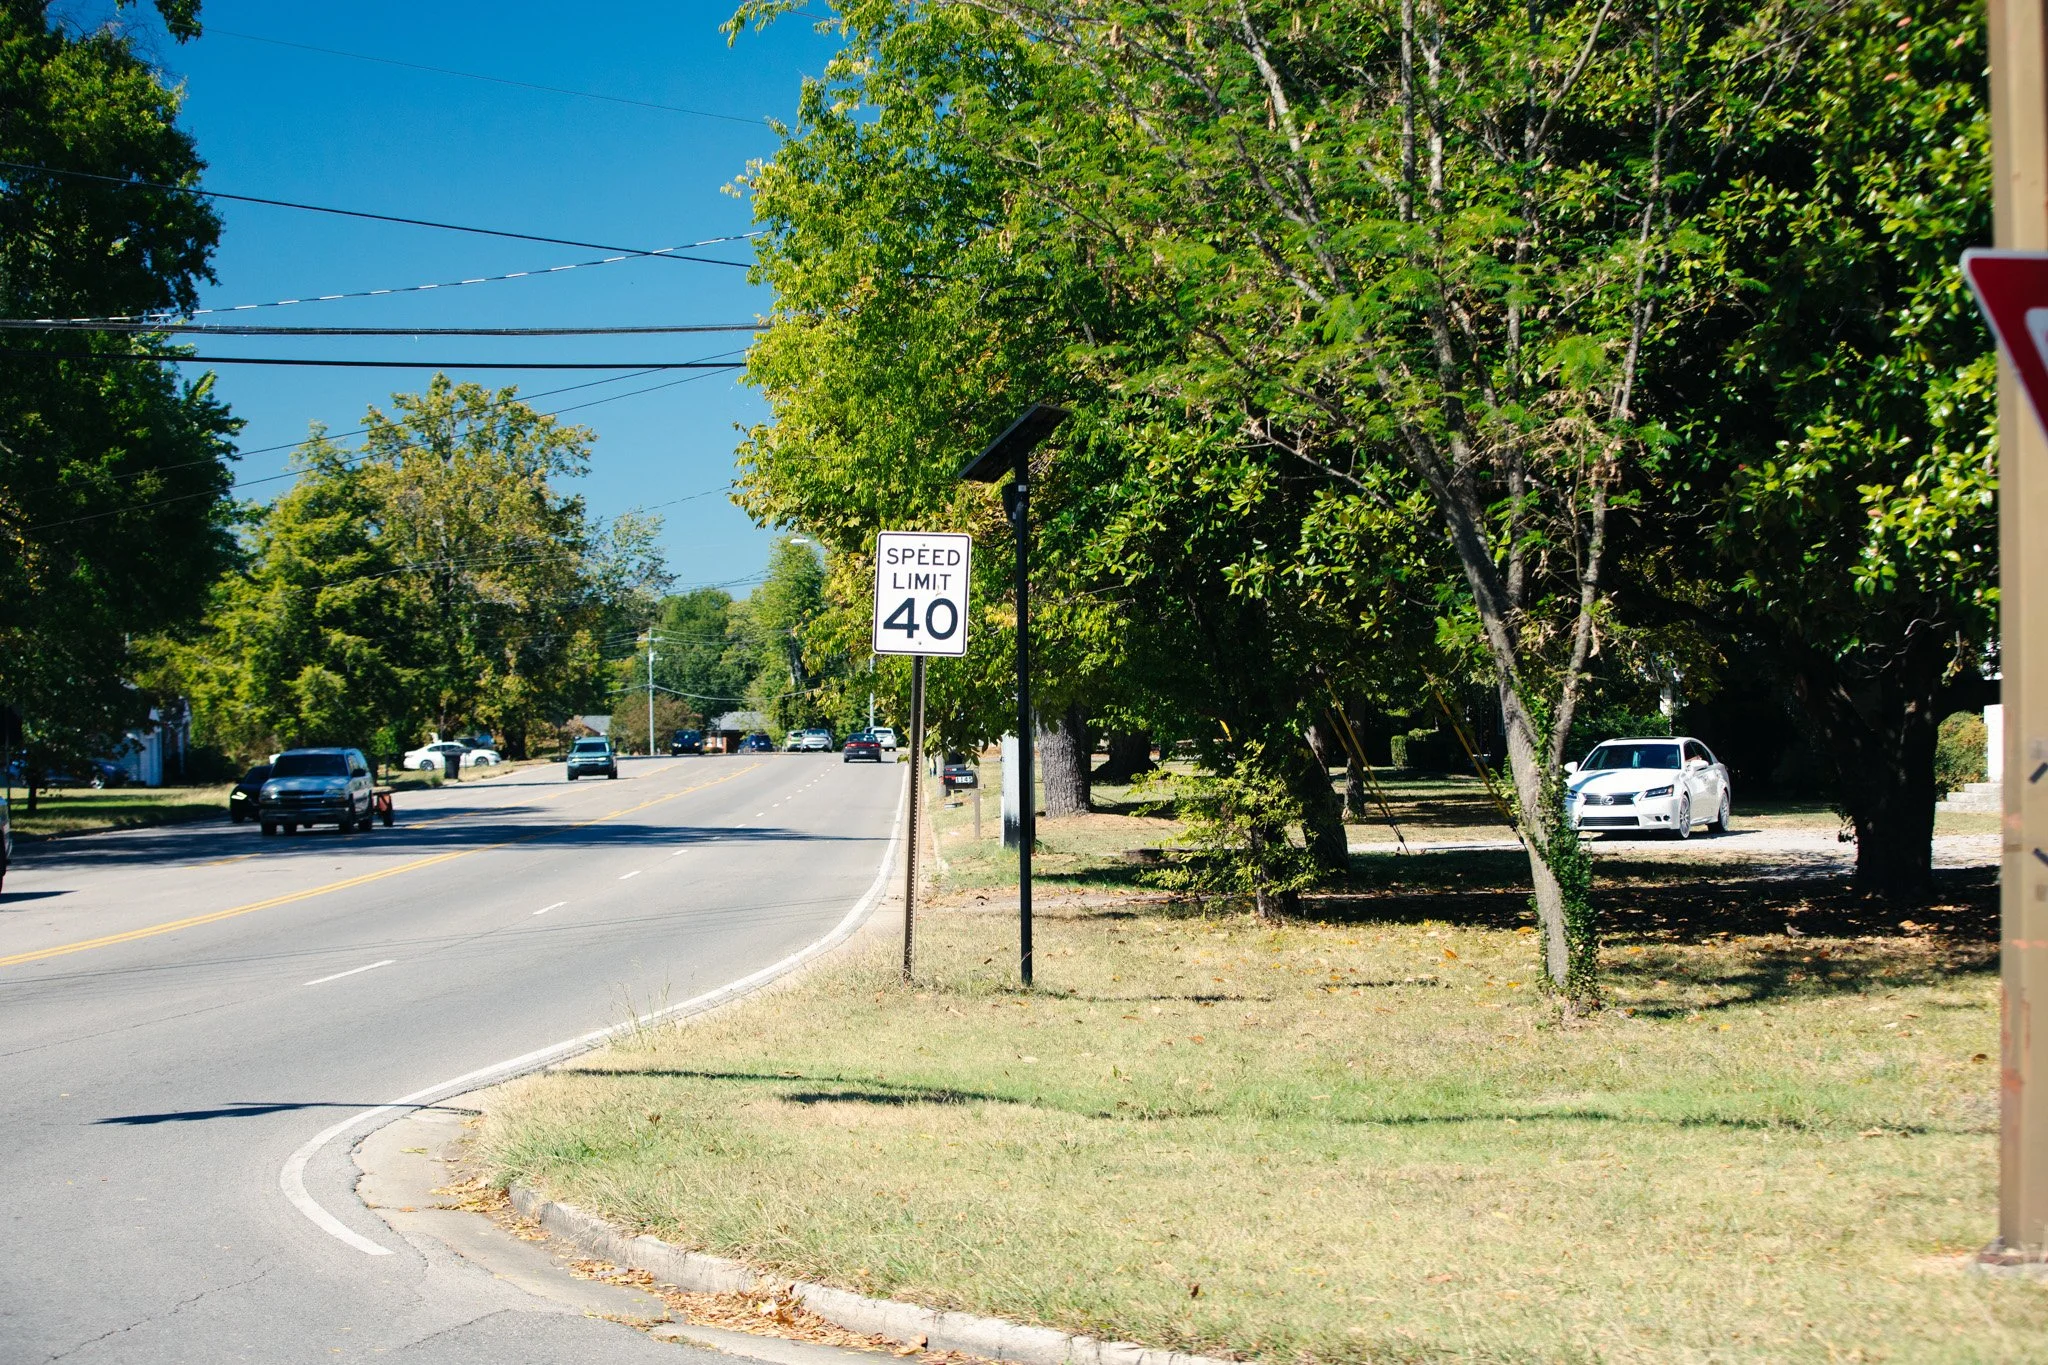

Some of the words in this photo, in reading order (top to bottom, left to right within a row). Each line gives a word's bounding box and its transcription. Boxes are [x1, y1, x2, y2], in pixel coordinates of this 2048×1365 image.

[886, 548, 961, 566] SPEED
[893, 572, 951, 590] LIMIT
[883, 597, 958, 640] 40
